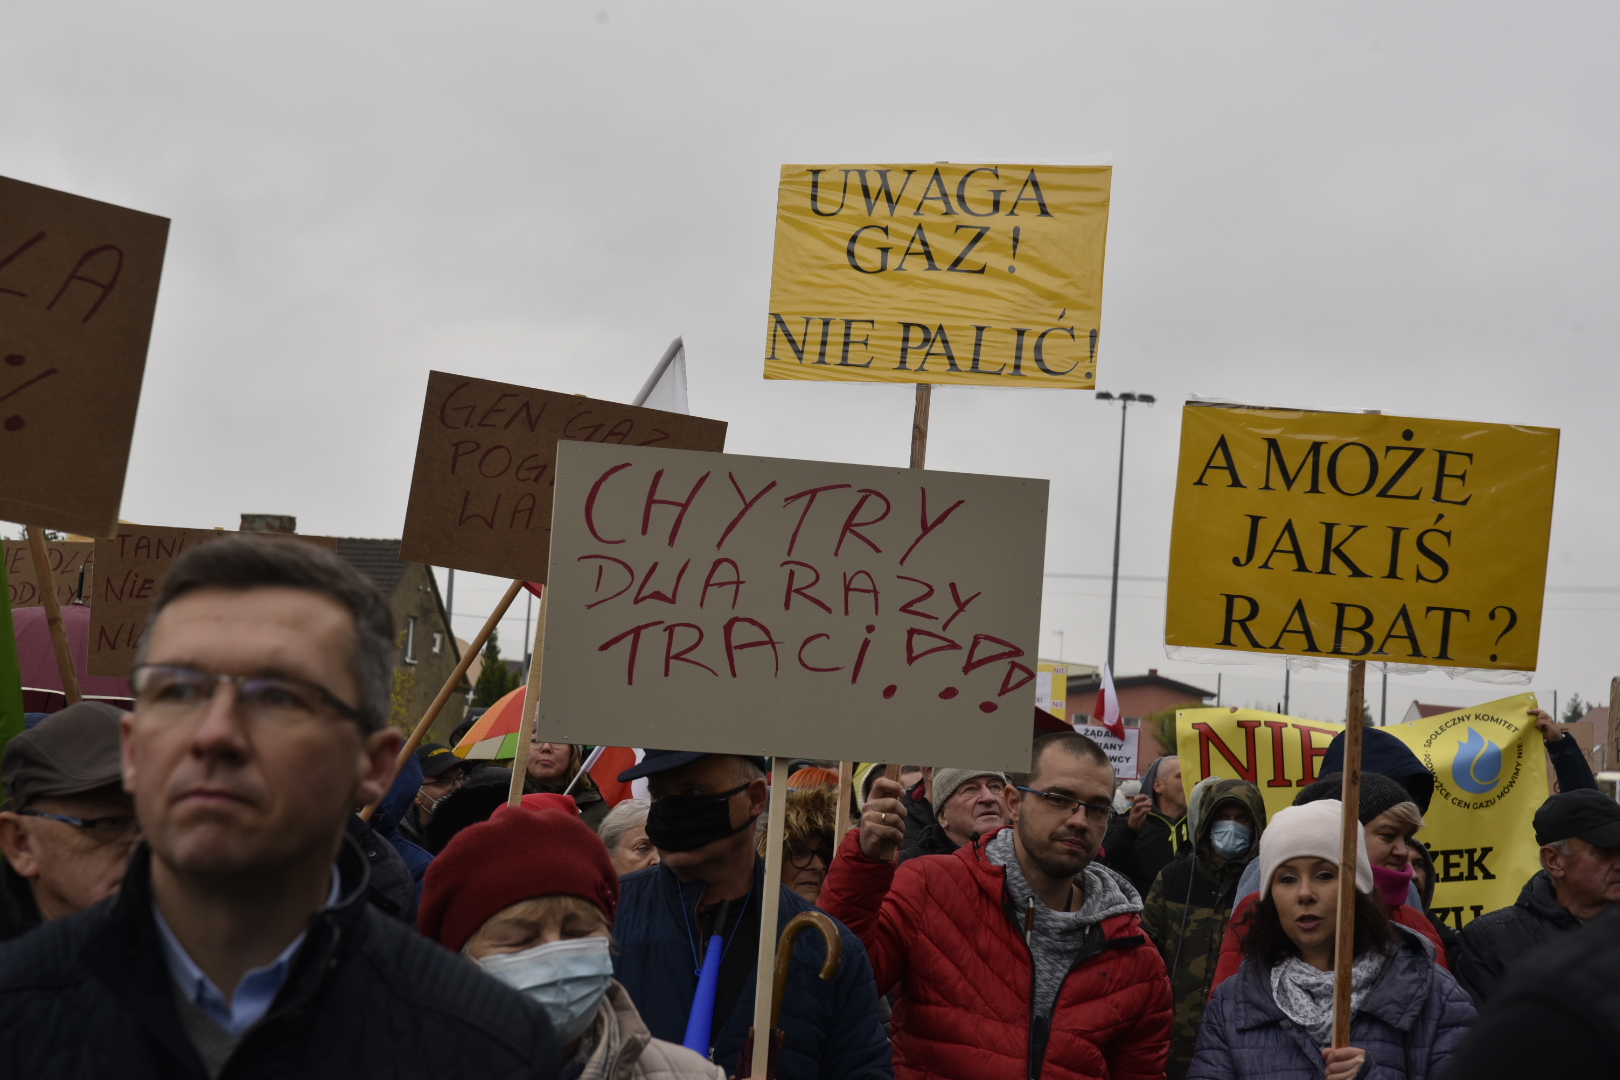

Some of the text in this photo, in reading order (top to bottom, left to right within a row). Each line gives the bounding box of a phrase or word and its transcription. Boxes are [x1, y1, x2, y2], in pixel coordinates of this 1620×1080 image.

[806, 166, 1054, 218] UWAGA
[764, 308, 1098, 379] NIE PALIĆ!
[451, 440, 555, 487] POG
[1193, 428, 1474, 506] A MOŻE
[584, 462, 965, 566] CHYTRY
[1231, 513, 1452, 583] JAKIŚ
[577, 554, 982, 632] DWA RAZY
[1054, 666, 1066, 675] NIE
[1191, 720, 1340, 788] NIE
[1423, 713, 1520, 748] SPOŁECZNY KOMITET
[1451, 797, 1470, 810] CEN
[1472, 799, 1496, 810] GAZU
[1496, 761, 1522, 801] MÓWIMY
[1516, 742, 1524, 759] NIE
